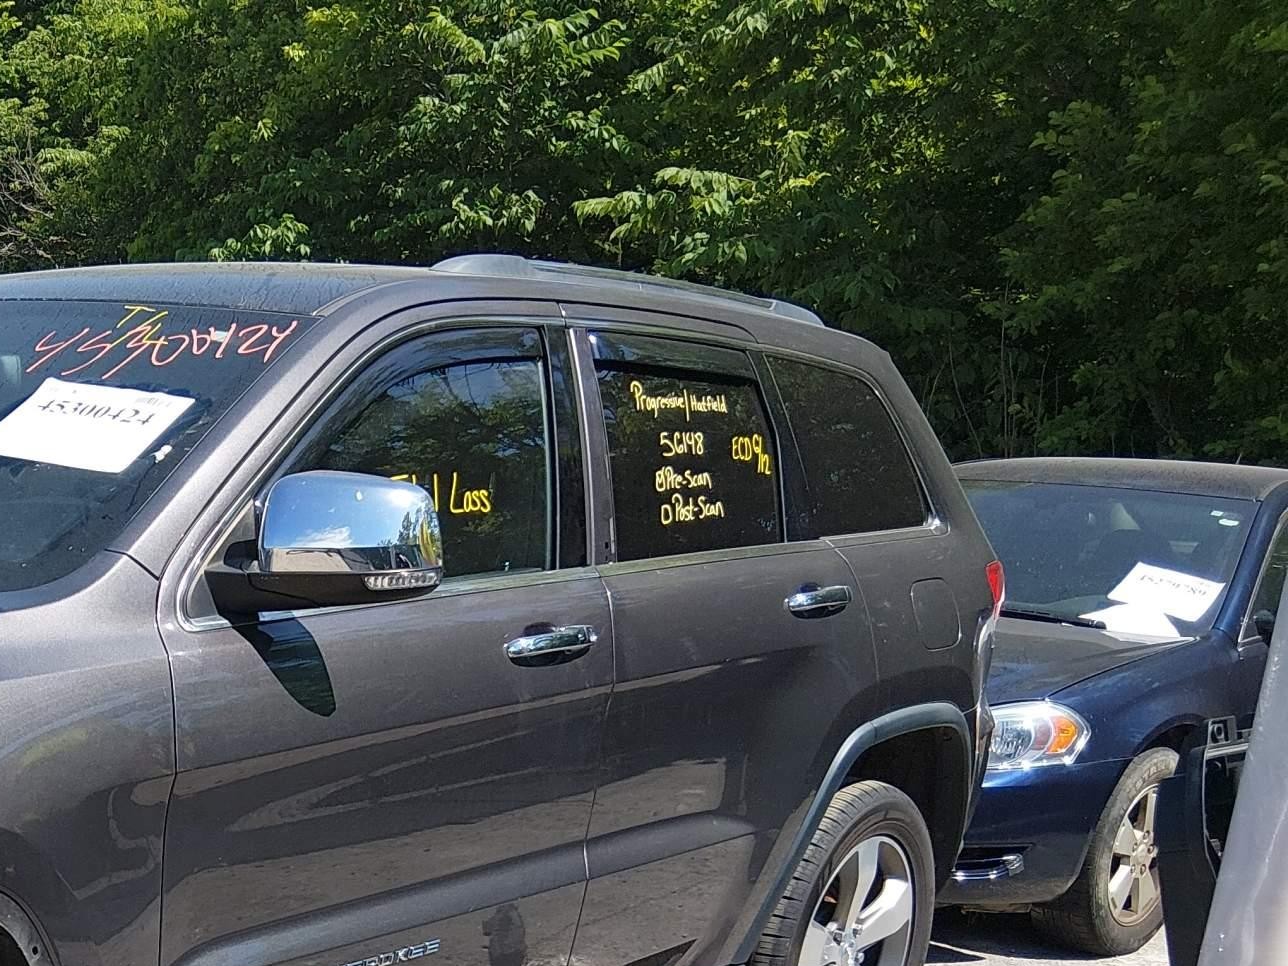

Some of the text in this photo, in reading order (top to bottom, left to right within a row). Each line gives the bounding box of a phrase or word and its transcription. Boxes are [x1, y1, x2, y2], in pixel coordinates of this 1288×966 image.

[26, 319, 298, 379] 45300424
[37, 399, 156, 426] 45300424
[732, 436, 752, 461] ECD
[664, 466, 712, 490] Pre-Scan
[672, 493, 724, 522] Post-Scan
